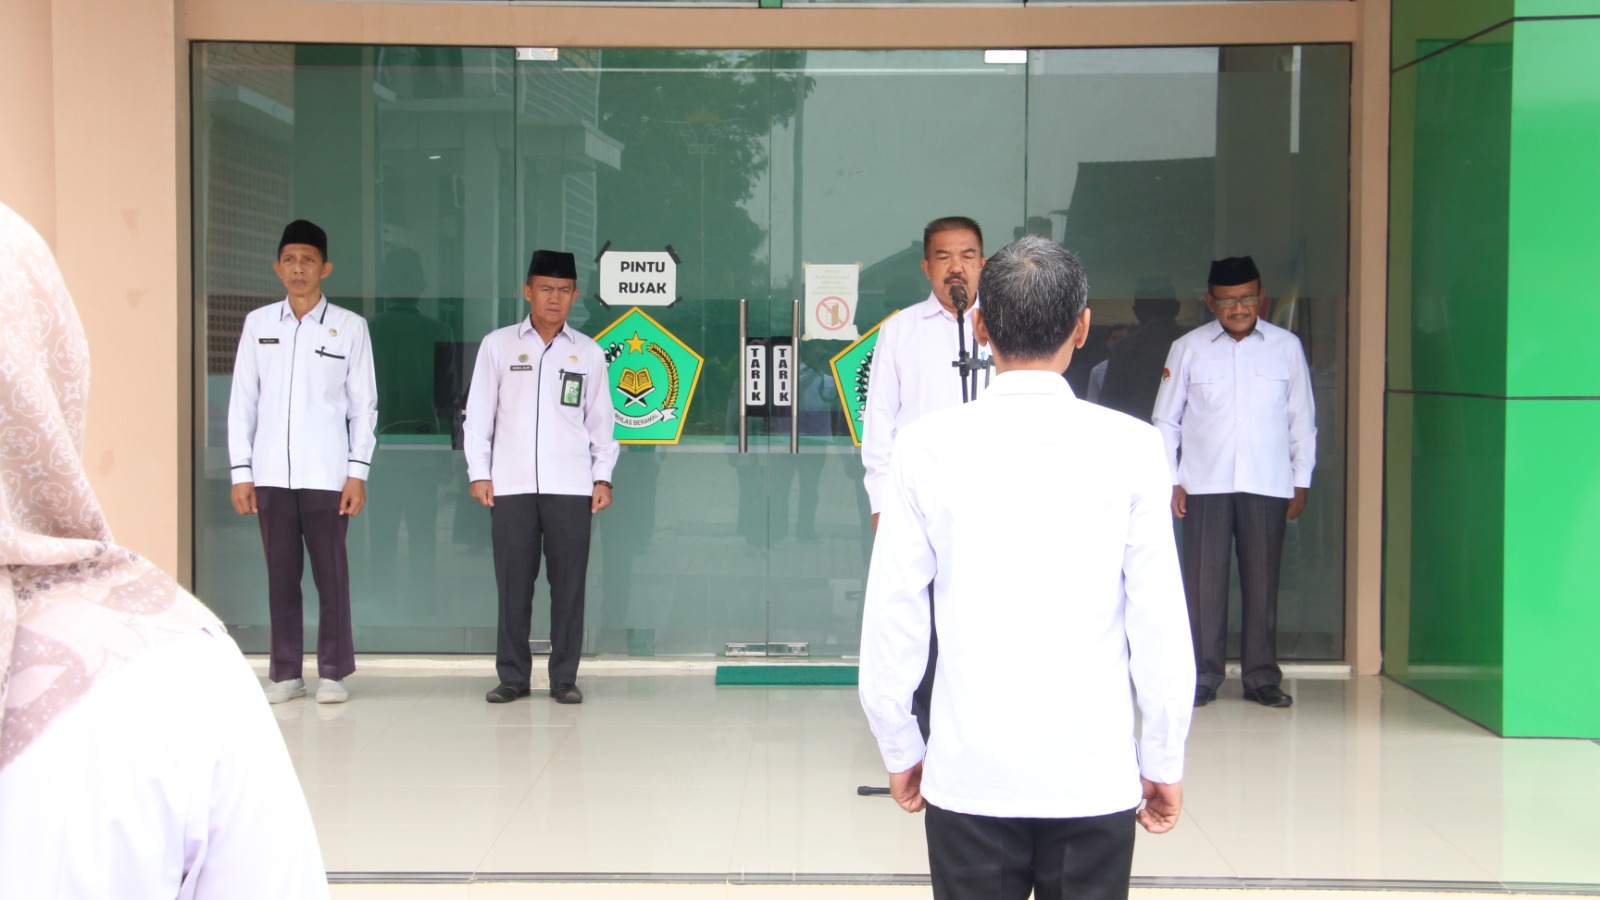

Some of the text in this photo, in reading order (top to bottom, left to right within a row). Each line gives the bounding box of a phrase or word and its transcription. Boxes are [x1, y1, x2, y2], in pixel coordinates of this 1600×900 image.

[620, 261, 666, 273] PINTU
[618, 282, 667, 294] RUSAK
[750, 348, 761, 401] TARIK
[778, 348, 789, 402] TARIK
[614, 413, 659, 425] KHLAS BERAMAL
